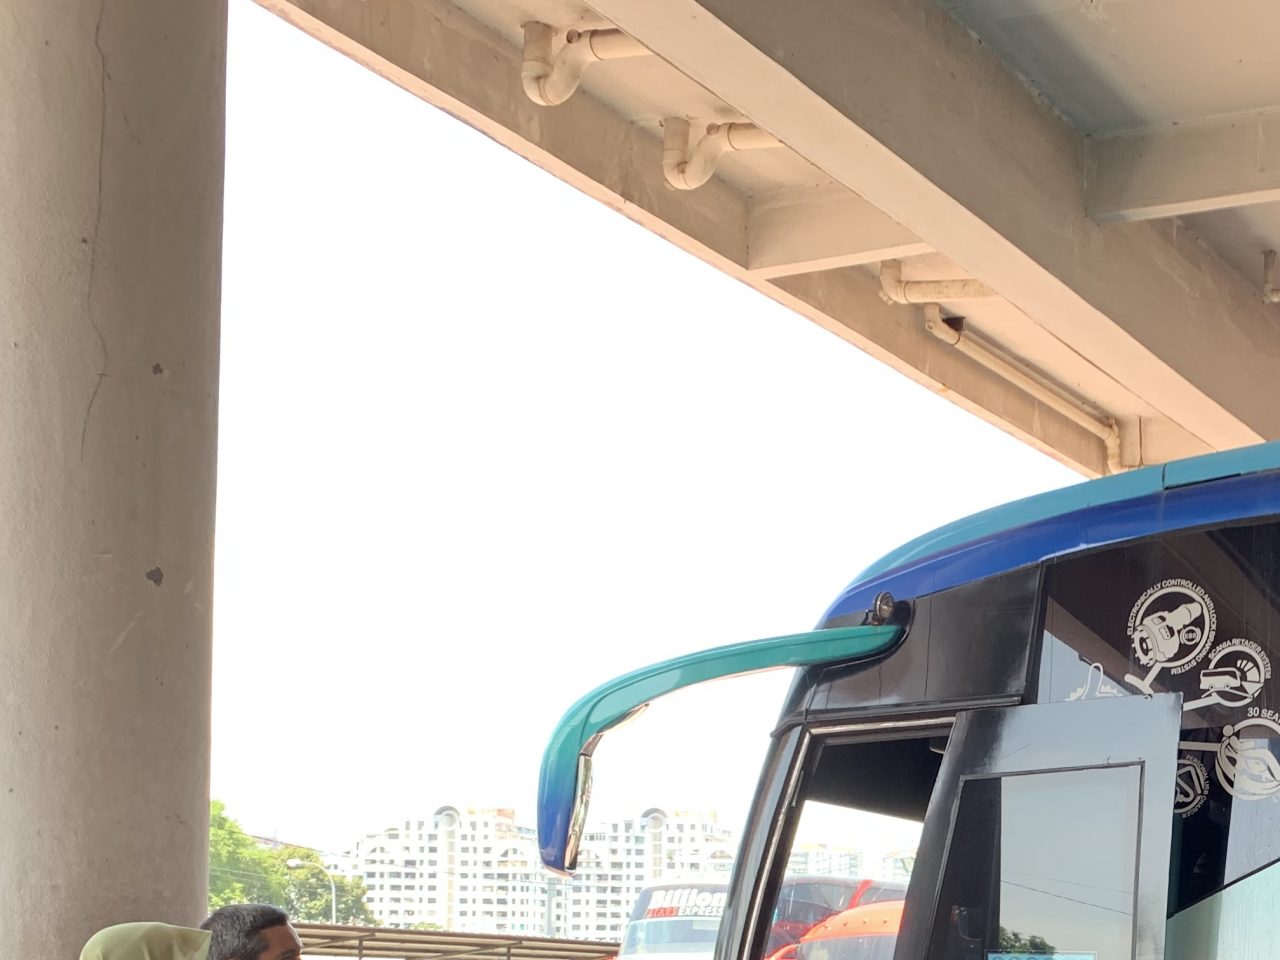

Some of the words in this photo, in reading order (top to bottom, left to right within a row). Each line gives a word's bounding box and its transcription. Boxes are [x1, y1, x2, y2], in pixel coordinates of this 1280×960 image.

[1126, 582, 1161, 636] ELECTRONICALLY
[1161, 578, 1204, 597] CONTROLLED
[1247, 707, 1260, 718] 30
